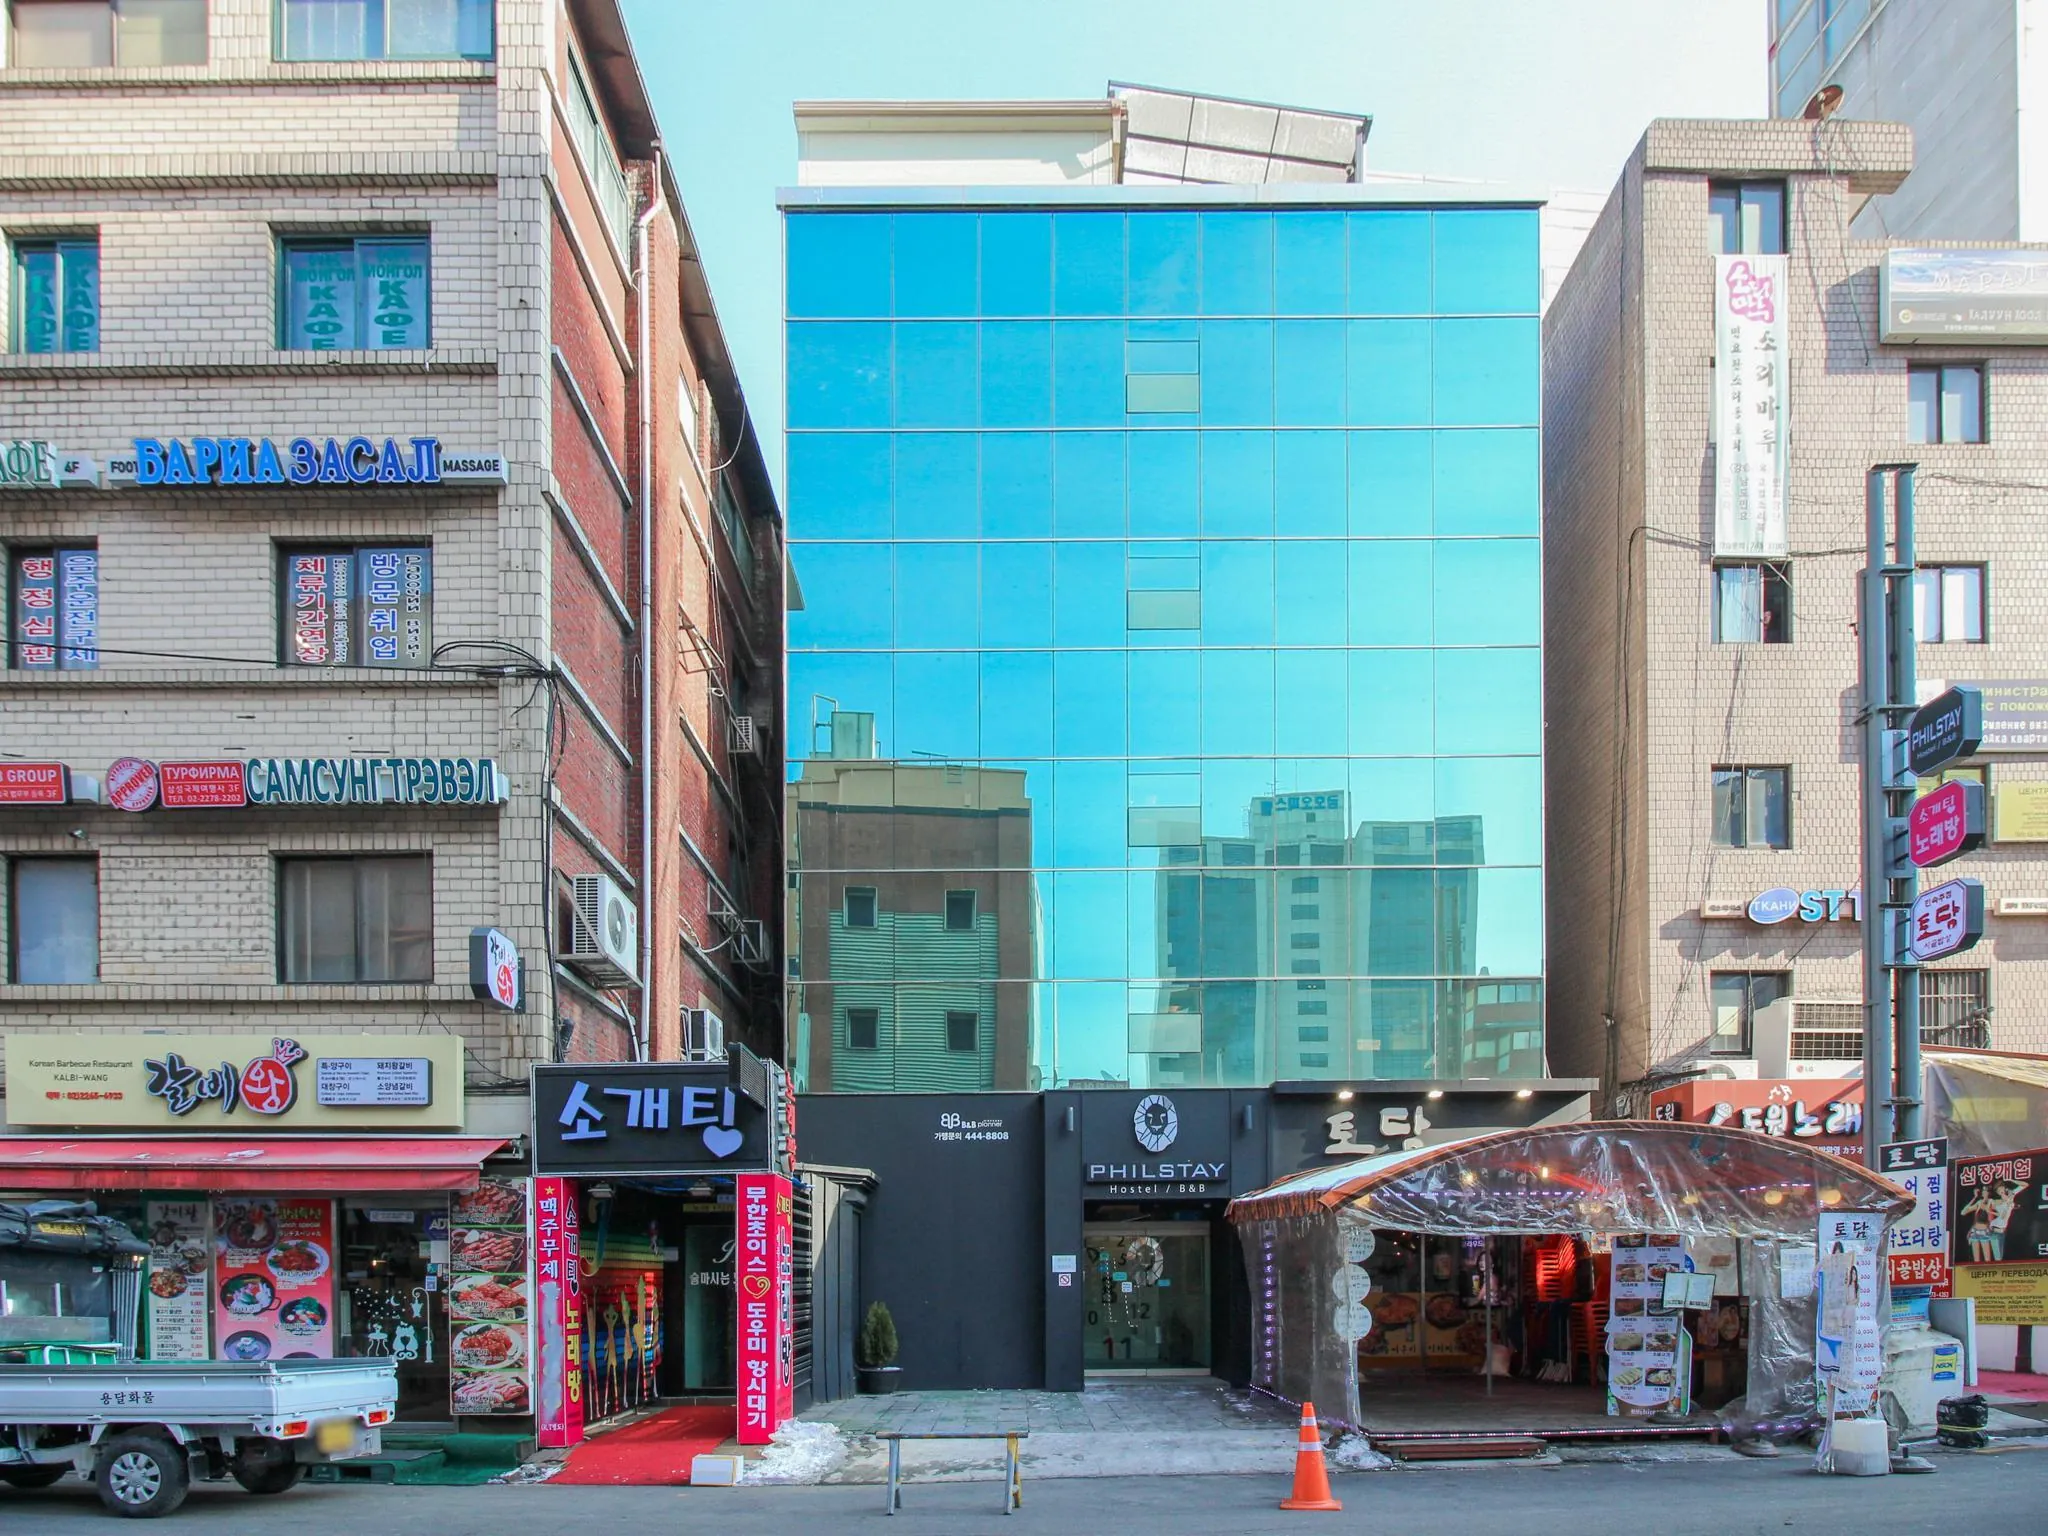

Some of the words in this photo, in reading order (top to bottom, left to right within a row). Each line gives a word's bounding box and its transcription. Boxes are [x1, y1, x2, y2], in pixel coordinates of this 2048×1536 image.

[65, 266, 96, 351] КАФЕ
[303, 286, 343, 350] КАФЕ
[374, 281, 413, 345] КАФЕ
[64, 461, 79, 473] 4F
[133, 437, 285, 485] БАРИА
[288, 436, 440, 484] ЗАСАЛ
[443, 460, 500, 472] MASSAGE
[22, 557, 56, 664] 행정심판
[64, 556, 98, 662] 음주운전구제
[296, 557, 329, 663] 체류기간연장
[370, 553, 401, 660] 방문취업
[1911, 706, 1962, 751] PHILSTAY
[7, 769, 57, 782] GROUP
[109, 763, 154, 806] APPROVED
[164, 766, 240, 780] ТУРФИРМА
[228, 784, 240, 793] 3F
[246, 758, 380, 804] САМСУНГ
[386, 758, 499, 804] ТРЭВЭЛ
[1919, 795, 1956, 824] 소개팅
[1916, 814, 1960, 856] 노래방
[1916, 901, 1960, 941] 토담
[143, 1052, 298, 1116] 갈비왕
[321, 1082, 350, 1091] 대창구이
[377, 1082, 413, 1091] 소양념갈비
[558, 1080, 743, 1158] 소개팅
[964, 1131, 1009, 1141] 444-8808
[1325, 1106, 1431, 1154] 토담
[1090, 1162, 1226, 1179] PHILSTAY
[1888, 1144, 1940, 1168] 토담
[1960, 1158, 2031, 1186] 신장개업
[1110, 1184, 1157, 1194] Hostel
[1179, 1184, 1206, 1193] B&B
[564, 1196, 579, 1296] 소개팅
[745, 1186, 767, 1272] 무한초이스
[1835, 1222, 1870, 1238] 토담
[1971, 1270, 1998, 1279] ЦЕНТР
[745, 1303, 767, 1354] 도우미
[565, 1300, 582, 1404] 노래방
[100, 1391, 155, 1405] 용달화물
[745, 1359, 768, 1429] 항시대기
